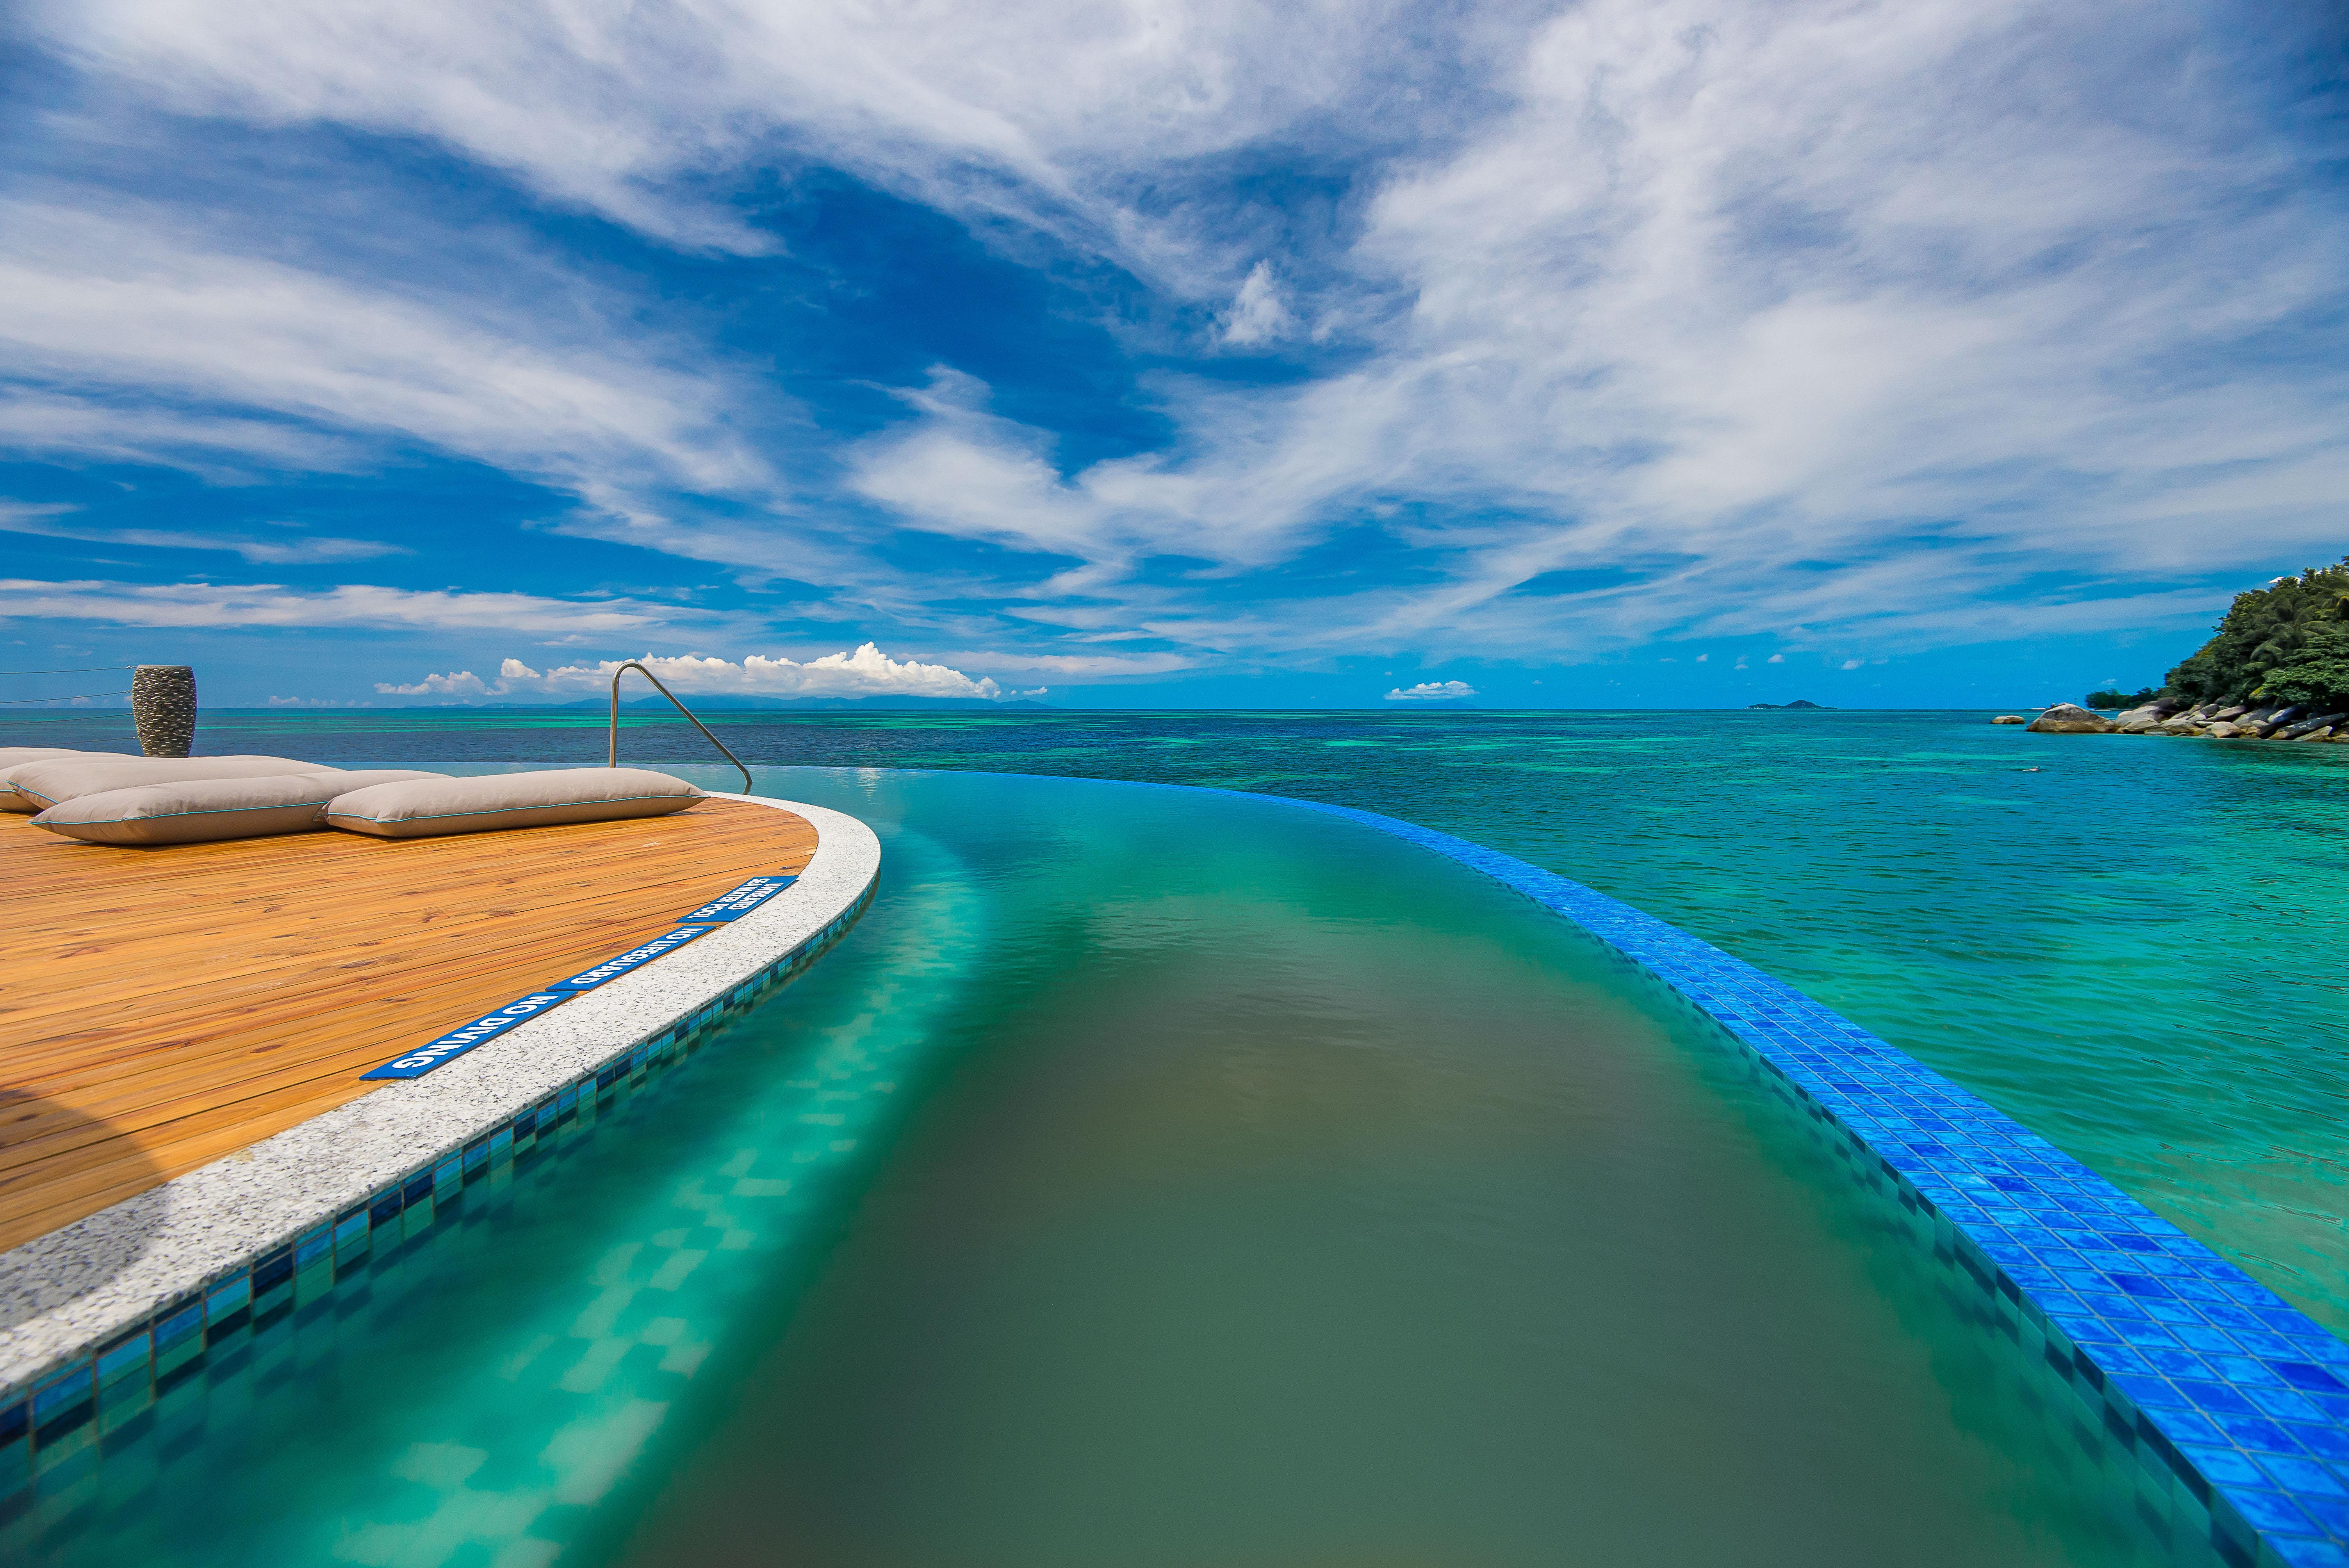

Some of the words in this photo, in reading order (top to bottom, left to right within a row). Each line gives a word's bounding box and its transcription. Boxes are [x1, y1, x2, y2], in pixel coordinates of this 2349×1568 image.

[727, 883, 784, 910] UNTREATED
[686, 903, 730, 919] POOL
[665, 928, 704, 939] NO
[570, 941, 678, 984] LIFEGUARD
[502, 996, 558, 1014] NO
[392, 1017, 516, 1069] DIVING
